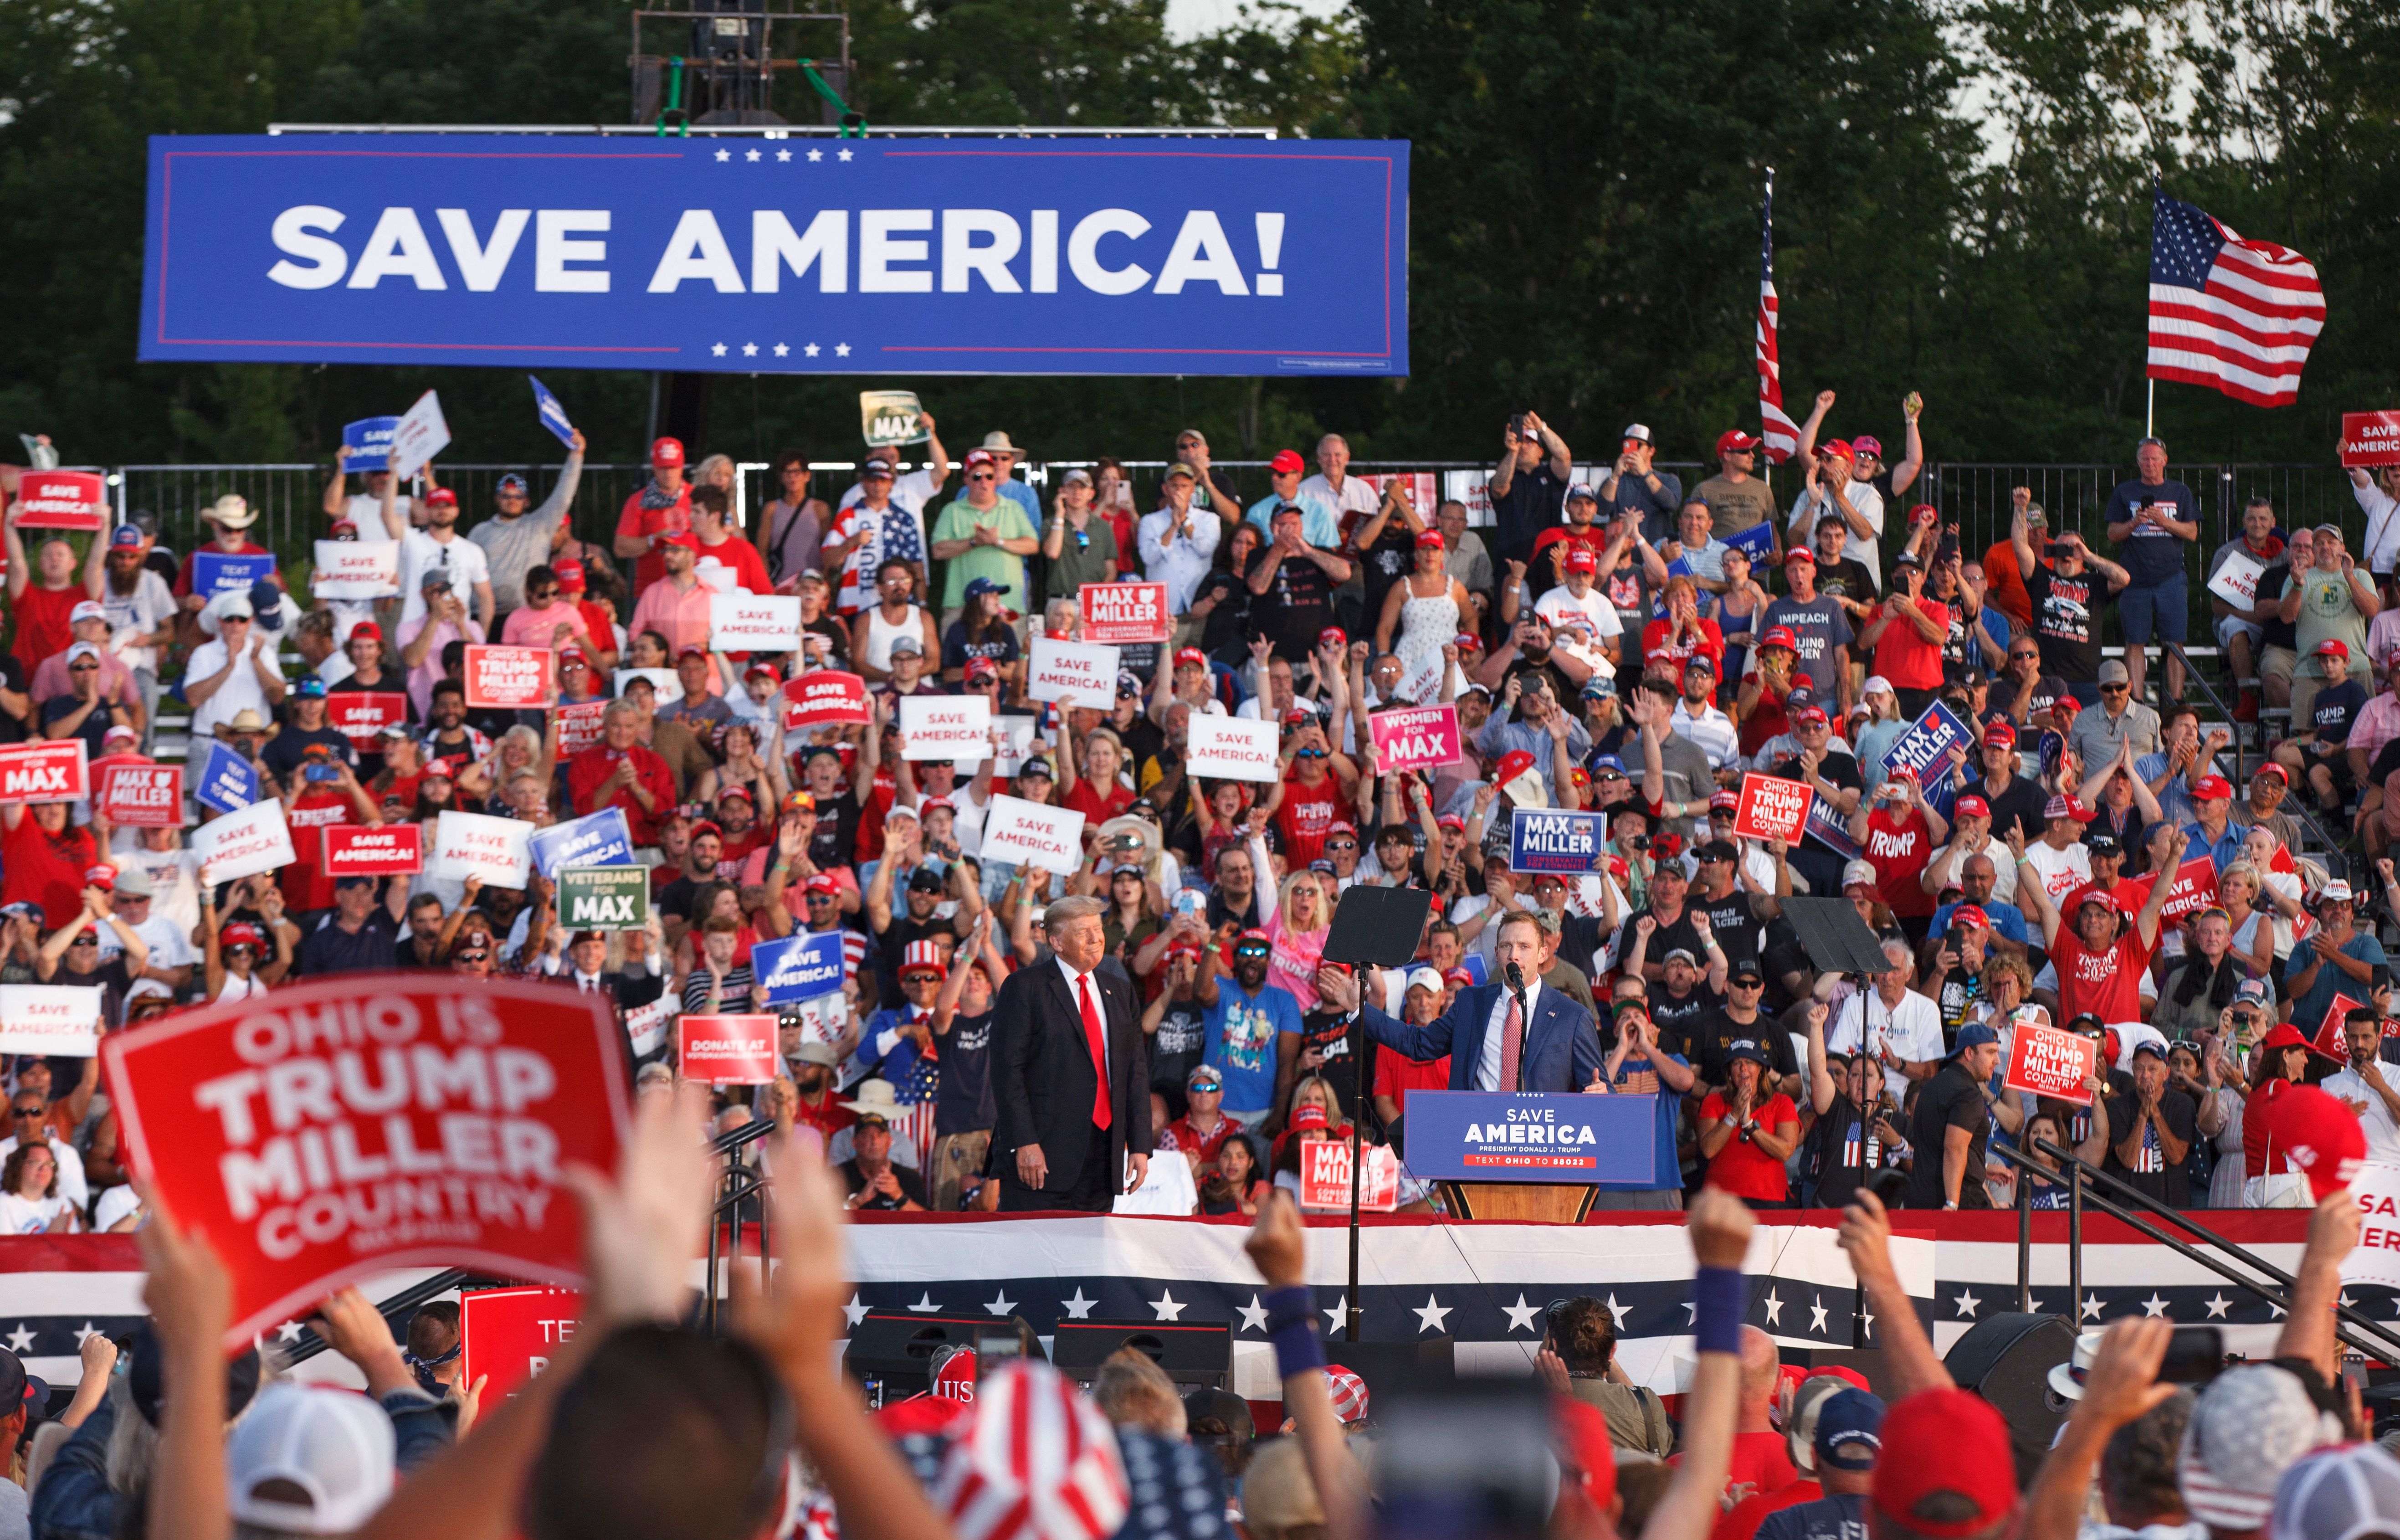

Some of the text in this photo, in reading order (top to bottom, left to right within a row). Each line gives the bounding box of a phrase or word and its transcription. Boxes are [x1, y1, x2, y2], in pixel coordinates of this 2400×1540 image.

[266, 203, 1286, 298] SAVE AMERICA!
[873, 415, 918, 437] MAX
[2363, 425, 2397, 437] SAVE
[365, 429, 395, 441] SAV
[2349, 440, 2400, 452] AMERIC
[41, 484, 81, 498] SAVE
[1469, 486, 1490, 495] SAV
[222, 565, 251, 575] TEXT
[340, 557, 375, 567] SAVE
[2243, 572, 2260, 586] SA
[1093, 588, 1133, 605] MAX
[2049, 581, 2088, 604] TRUMP
[2222, 576, 2254, 601] AMER
[737, 611, 774, 620] SAVE
[1091, 604, 1158, 623] MILLER
[1779, 613, 1828, 625] IMPEACH
[720, 626, 792, 635] AMERICA!
[1095, 625, 1154, 633] CONSERVATIVE
[1795, 637, 1825, 649] IJING
[485, 650, 532, 659] OHIO IS
[1800, 648, 1821, 659] DEN
[478, 659, 542, 675] TRUMP
[1055, 657, 1092, 672] SAVE
[478, 674, 539, 688] MILLER
[1038, 672, 1108, 691] AMERICA!
[1408, 667, 1434, 693] SAVE
[482, 688, 536, 698] COUNTRY
[805, 683, 846, 696] SAVE
[792, 699, 862, 714] AMERICA!
[2029, 696, 2054, 710] UMP
[345, 708, 383, 721] SAVE
[565, 709, 594, 718] OHIO
[928, 713, 965, 724] SAVE
[1384, 711, 1444, 728] WOMEN
[559, 716, 602, 731] TRUM
[1405, 725, 1425, 734] FOR
[559, 730, 603, 745] MILL
[911, 730, 983, 741] AMERICA!
[1216, 733, 1253, 745] SAVE
[1198, 748, 1269, 763] AMERICA!
[1389, 734, 1446, 762] MAX
[1893, 730, 1930, 765] MAX
[114, 771, 149, 786] MAX
[1892, 764, 1912, 777] USA
[6, 767, 68, 793] MAX
[1763, 780, 1800, 796] OHIO IS
[109, 787, 172, 806] MILLER
[1754, 789, 1803, 811] TRUMP
[291, 806, 346, 820] TRUMP
[1752, 809, 1799, 825] MILLER
[1812, 800, 1850, 837] MILL
[1016, 818, 1054, 834] SAVE
[1525, 816, 1569, 834] MAX
[1753, 819, 1795, 834] COUNTRY
[218, 824, 256, 845] SAVE
[352, 835, 395, 846] SAVE
[466, 833, 505, 847] SAVE
[206, 836, 280, 866] AMERICA!
[559, 832, 601, 855] SAVE
[995, 832, 1067, 855] AMERICA!
[1523, 834, 1592, 853] MILLER
[1870, 829, 1915, 857] TRUMP
[333, 850, 414, 862] AMERICA!
[446, 845, 520, 867] AMERICA!
[566, 871, 643, 884] VETERANS
[592, 886, 616, 894] FOR
[2166, 883, 2194, 898] AVE
[572, 895, 635, 922] MAX
[2160, 894, 2215, 917] MERICA!
[778, 950, 820, 971] SAVE
[1270, 954, 1316, 978] TRUMP
[764, 965, 838, 989] AMERICA!
[28, 1003, 69, 1017] SAVE
[9, 1023, 90, 1036] AMERICA!
[232, 993, 503, 1066] OHIO IS
[2382, 1022, 2394, 1032] IS
[691, 1039, 766, 1051] DONATE AT
[2035, 1031, 2077, 1047] OHIO IS
[2026, 1040, 2084, 1066] TRUMP
[2023, 1057, 2082, 1079] MILLER
[2025, 1070, 2076, 1089] COUNTRY
[193, 1046, 558, 1145] TRUMP
[1507, 1109, 1554, 1122] SAVE
[1464, 1124, 1596, 1144] AMERICA
[2152, 1125, 2163, 1172] RUMP
[220, 1114, 560, 1222] MILLER
[1313, 1164, 1385, 1186] MILER
[2360, 1194, 2400, 1216] SA
[256, 1184, 550, 1260] COUNTRY
[538, 1320, 576, 1342] TE
[944, 1381, 973, 1402] US
